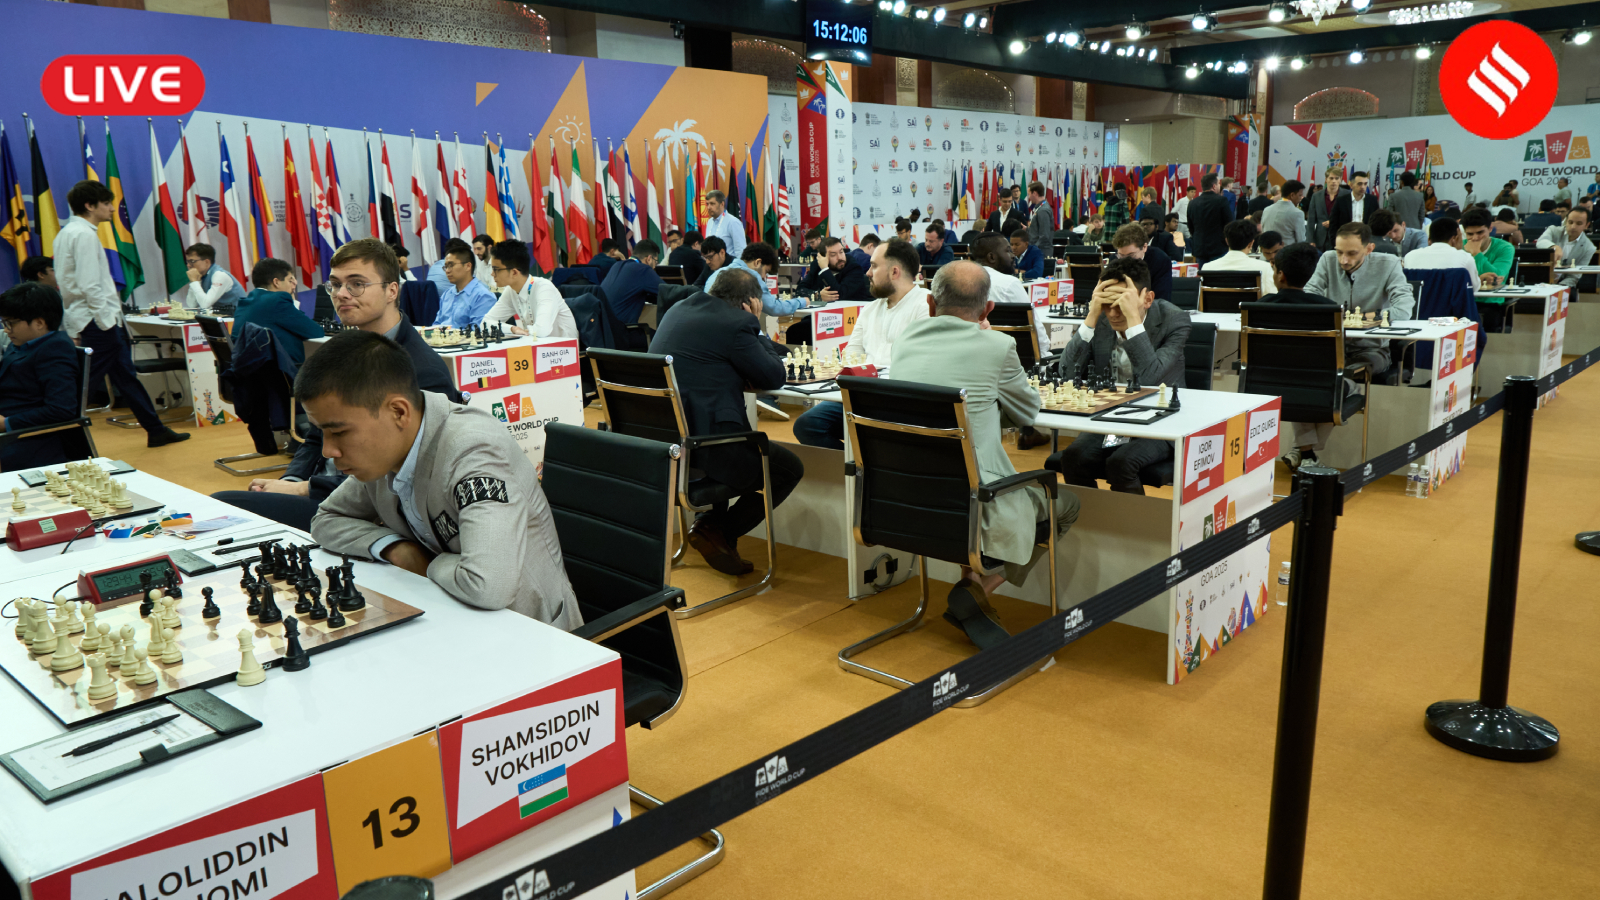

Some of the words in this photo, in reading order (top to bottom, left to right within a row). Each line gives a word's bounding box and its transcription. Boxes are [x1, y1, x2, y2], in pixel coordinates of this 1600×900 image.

[813, 20, 867, 44] 15:12:06
[1452, 171, 1476, 179] CUP
[1523, 168, 1549, 177] FIDE
[1552, 166, 1598, 176] WORLD
[1522, 178, 1544, 186] GOA
[542, 350, 558, 358] BANH
[471, 360, 494, 369] DANIEL
[514, 359, 529, 371] 39
[470, 367, 497, 377] DARDHA
[513, 420, 542, 432] WORLD
[1250, 424, 1260, 439] EDIZ
[1198, 440, 1212, 454] IGOR
[1230, 437, 1240, 457] 15
[1194, 452, 1215, 471] EFIMOV
[1201, 570, 1213, 587] GOA
[1214, 560, 1228, 578] 2025
[471, 700, 600, 767] SHAMSIDDIN
[484, 728, 592, 786] VOKHIDOV
[362, 796, 421, 850] 13
